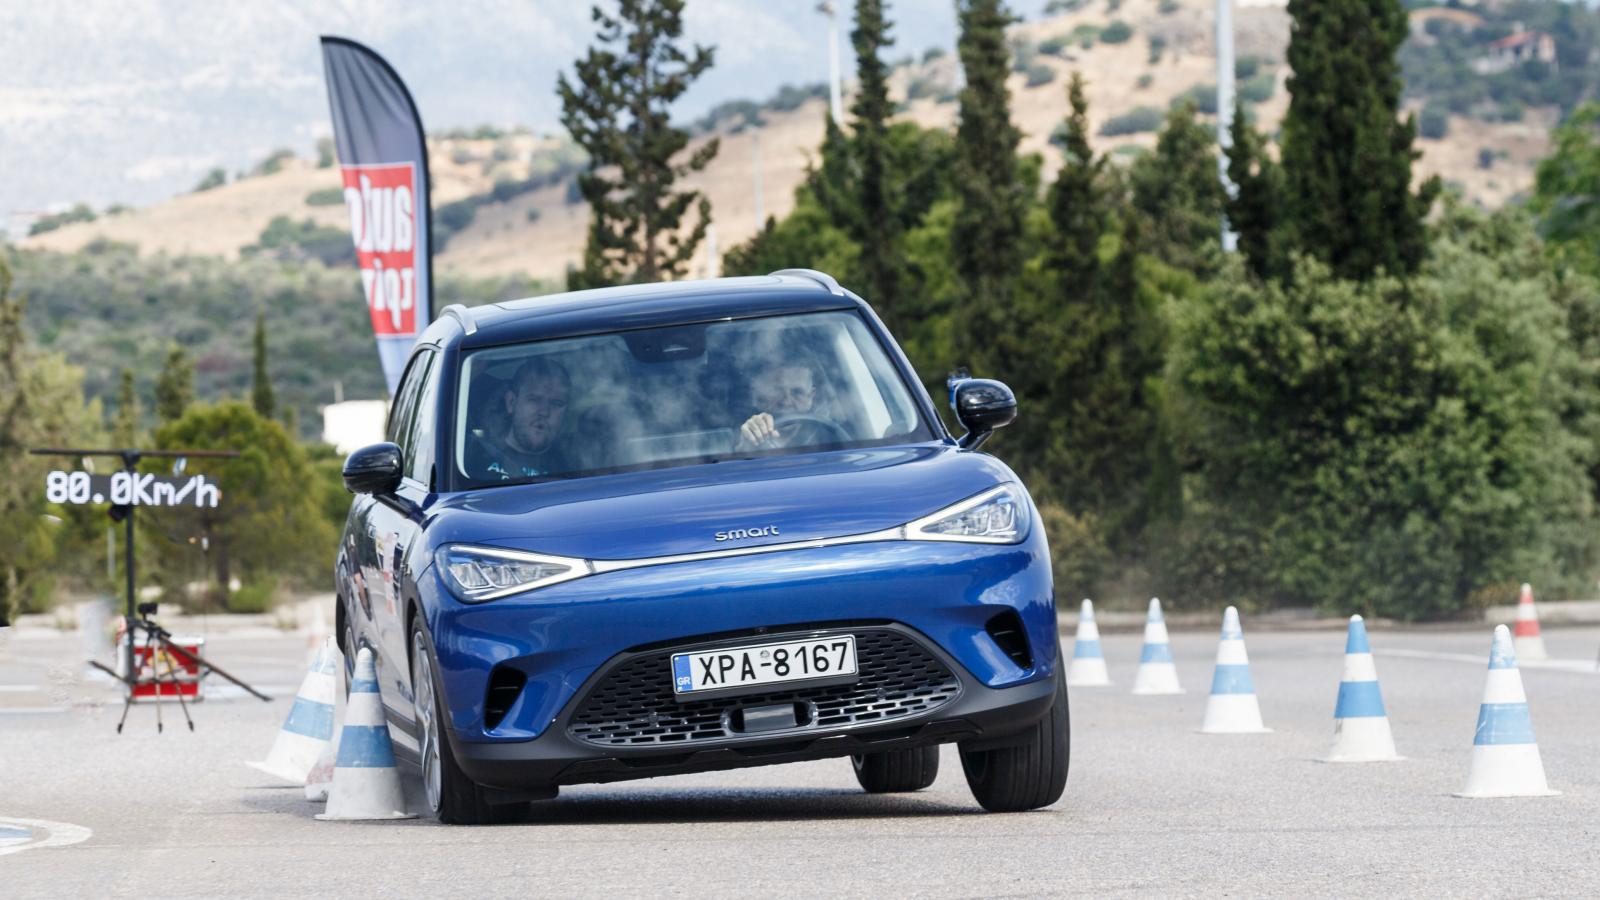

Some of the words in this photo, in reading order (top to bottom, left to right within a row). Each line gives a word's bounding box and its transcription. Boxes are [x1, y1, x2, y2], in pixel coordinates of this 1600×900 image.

[715, 524, 779, 541] smart
[699, 642, 848, 686] XPA-8167
[676, 676, 691, 686] GR
